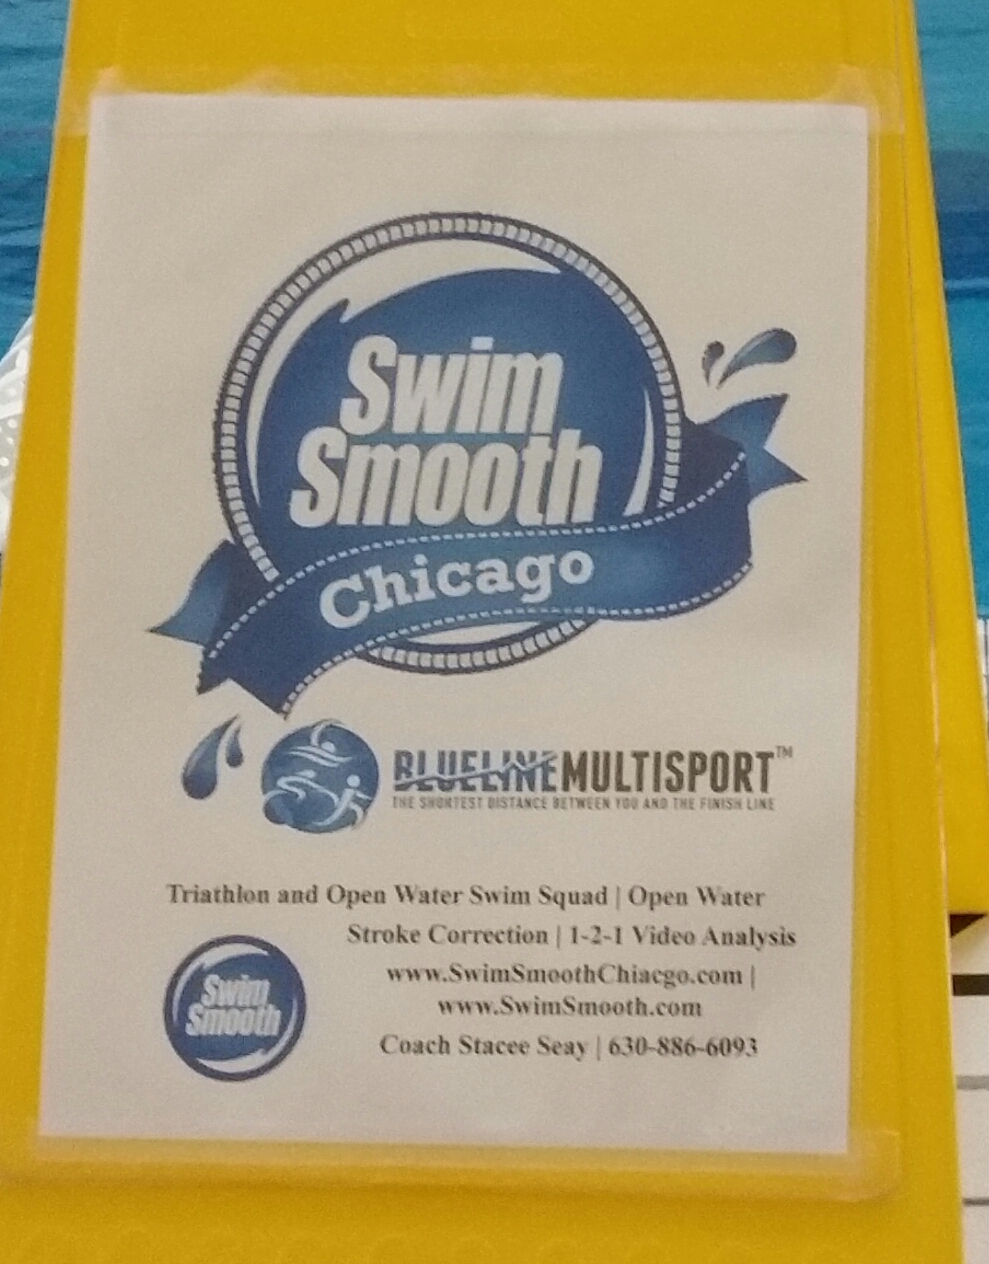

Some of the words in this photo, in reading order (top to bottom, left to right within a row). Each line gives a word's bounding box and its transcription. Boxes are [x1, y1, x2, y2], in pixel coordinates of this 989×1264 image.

[339, 334, 565, 436] Swim
[288, 424, 604, 529] Smooth
[318, 550, 595, 629] Chicago
[392, 796, 415, 811] THE
[418, 797, 483, 811] SHORTEST
[487, 797, 547, 811] DISTANCE
[552, 797, 611, 812] BETWEEN
[615, 798, 639, 812] YOU
[642, 798, 668, 811] AND
[673, 797, 695, 812] THE
[700, 797, 742, 812] FINISH
[746, 798, 774, 812] LINE
[166, 883, 270, 905] Triathlon
[277, 885, 318, 906] and
[326, 885, 386, 911] Open
[394, 885, 464, 906] Water
[470, 886, 531, 906] Swim
[538, 886, 608, 912] Squad
[627, 886, 688, 913] Open
[696, 887, 766, 908] Water
[347, 924, 421, 945] Stroke
[428, 925, 548, 946] Correction
[571, 925, 622, 946] 1-2-1
[632, 926, 696, 947] Video
[703, 927, 797, 953] Analysis
[202, 974, 271, 1007] Swim
[387, 964, 743, 991] www.SwimSmoothChiacgo.com
[185, 1002, 283, 1036] Smooth
[437, 996, 702, 1018] www.SwimSmooth.com
[379, 1035, 451, 1057] Coach
[458, 1036, 530, 1057] Stacee
[537, 1037, 586, 1063] Seay
[608, 1037, 758, 1058] 630-886-6093
